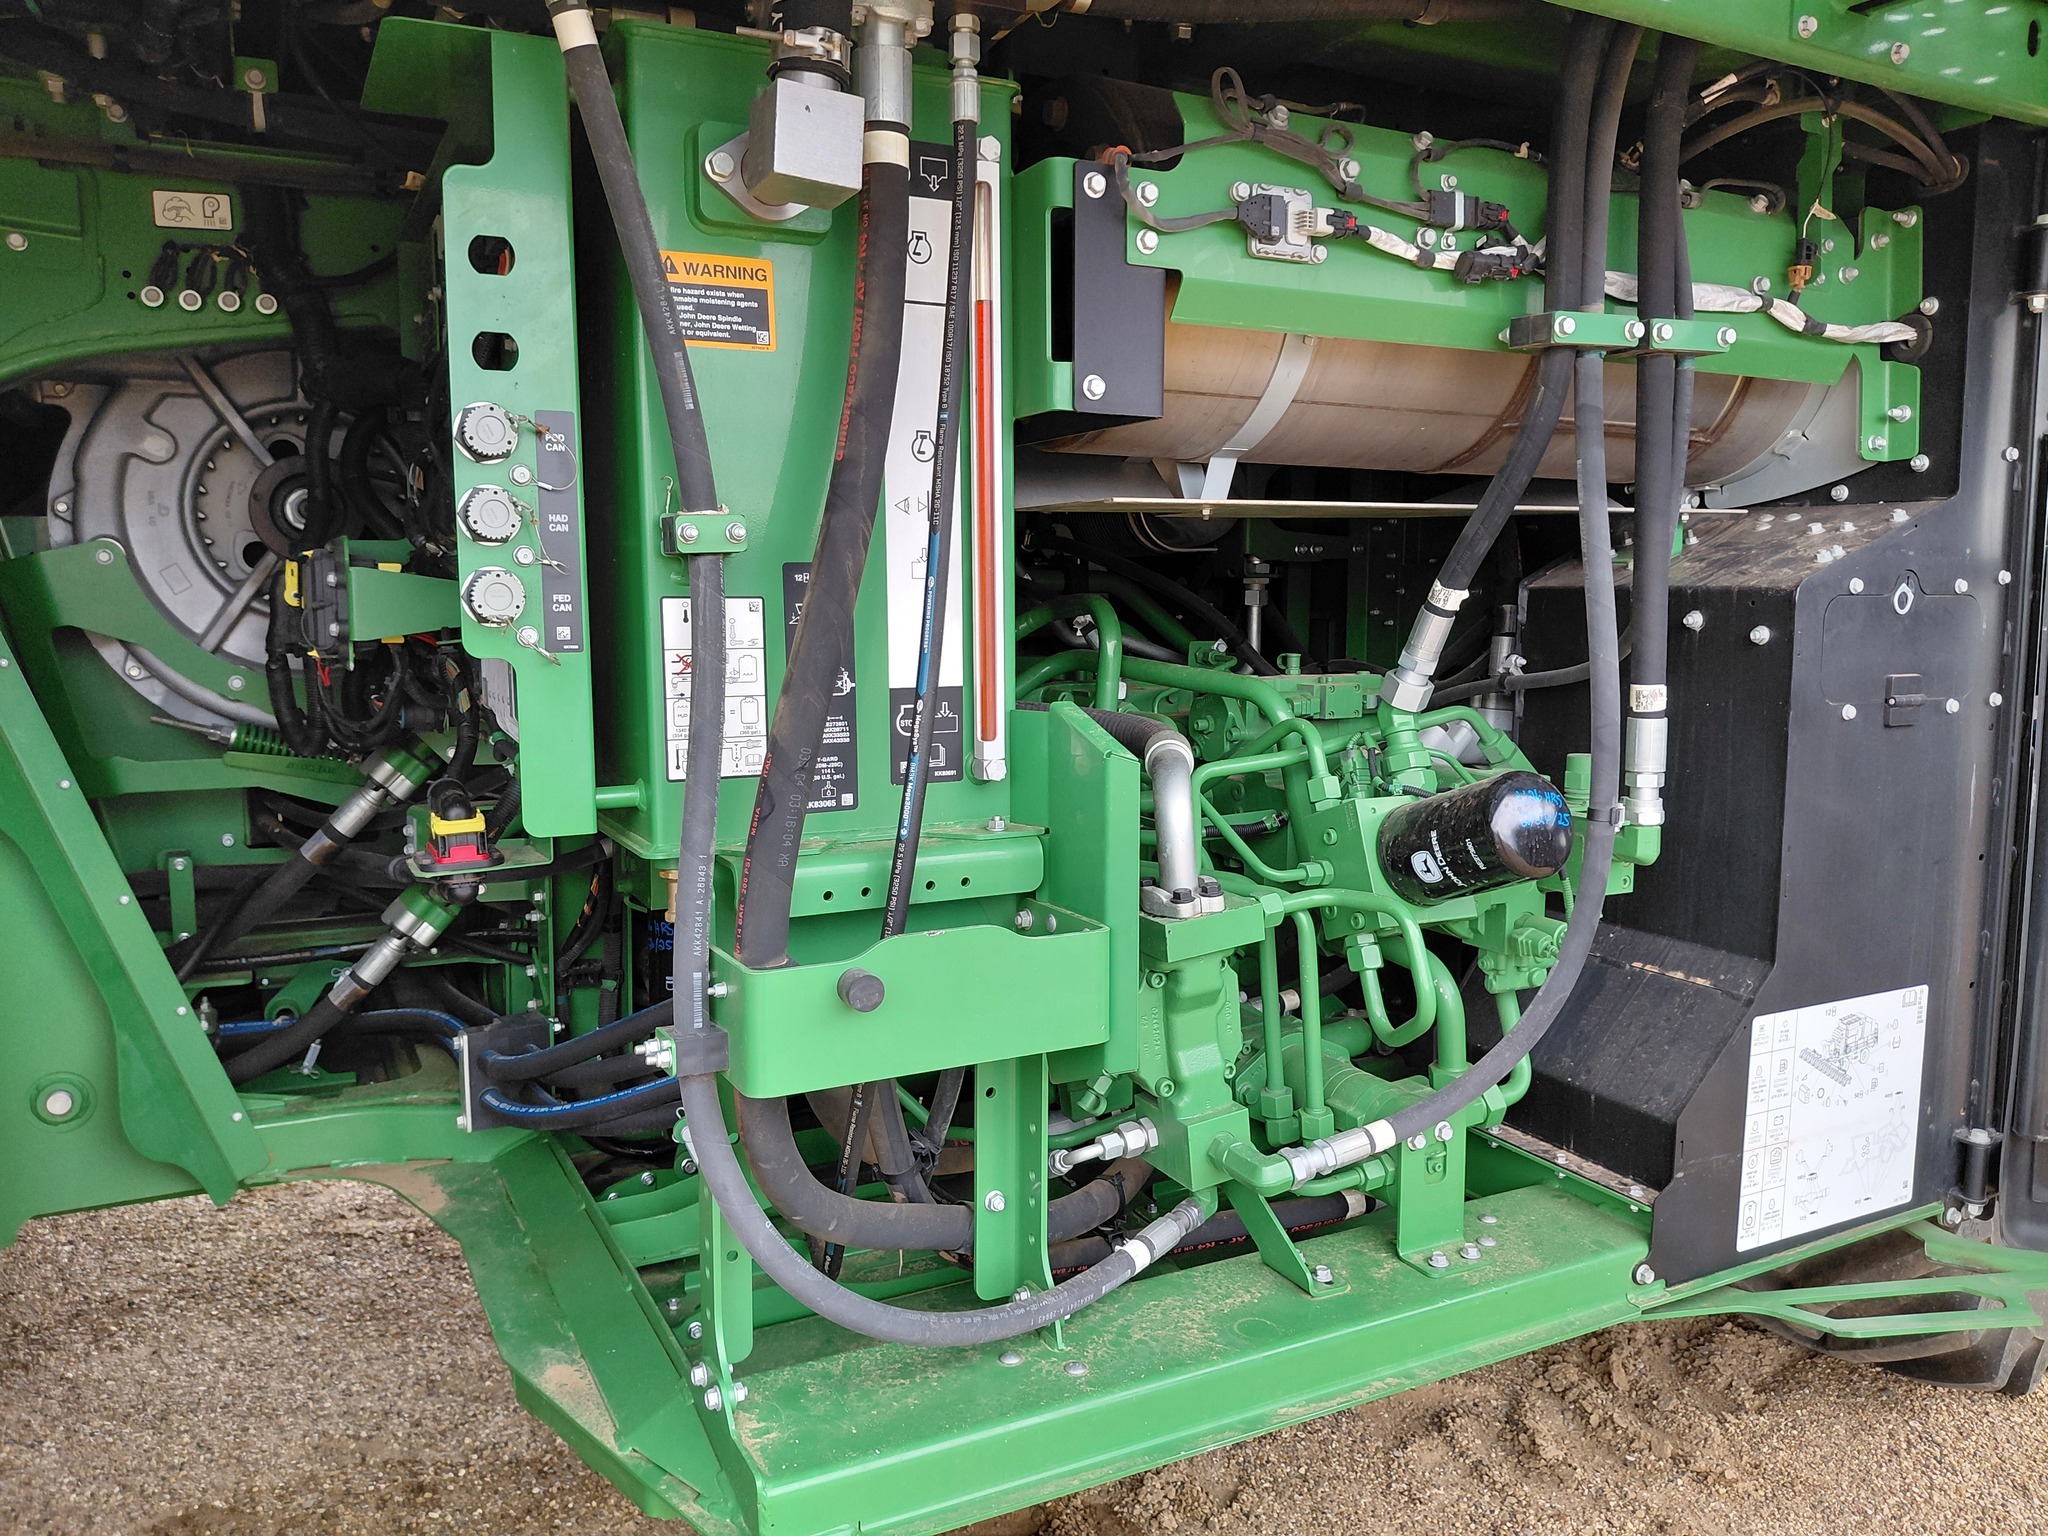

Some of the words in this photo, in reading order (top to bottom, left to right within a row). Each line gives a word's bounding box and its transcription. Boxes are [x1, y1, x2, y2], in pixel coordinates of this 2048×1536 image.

[683, 261, 768, 282] WARNING
[682, 287, 705, 296] hazard
[706, 290, 726, 298] exists
[726, 291, 745, 299] when
[699, 298, 736, 307] moistening
[736, 301, 759, 309] agents
[679, 312, 696, 320] John
[697, 313, 717, 321] Deere
[717, 314, 742, 323] Spindle
[694, 321, 711, 329] John
[732, 324, 757, 333] Wetting
[695, 330, 731, 338] equivalent.
[545, 442, 566, 452] CAN
[548, 513, 569, 523] HAD
[549, 523, 569, 533] CAN
[552, 594, 571, 603] FED
[552, 603, 573, 612] CAN
[762, 751, 773, 778] ITALY
[806, 799, 837, 809] K83065
[1544, 791, 1563, 809] HRS
[750, 806, 761, 836] MSHA
[1430, 829, 1447, 866] DEERE
[743, 857, 752, 877] PSI
[1444, 866, 1469, 888] JOHN
[741, 878, 749, 895] 200
[737, 903, 745, 926] BAR
[693, 911, 704, 956] AKK42841
